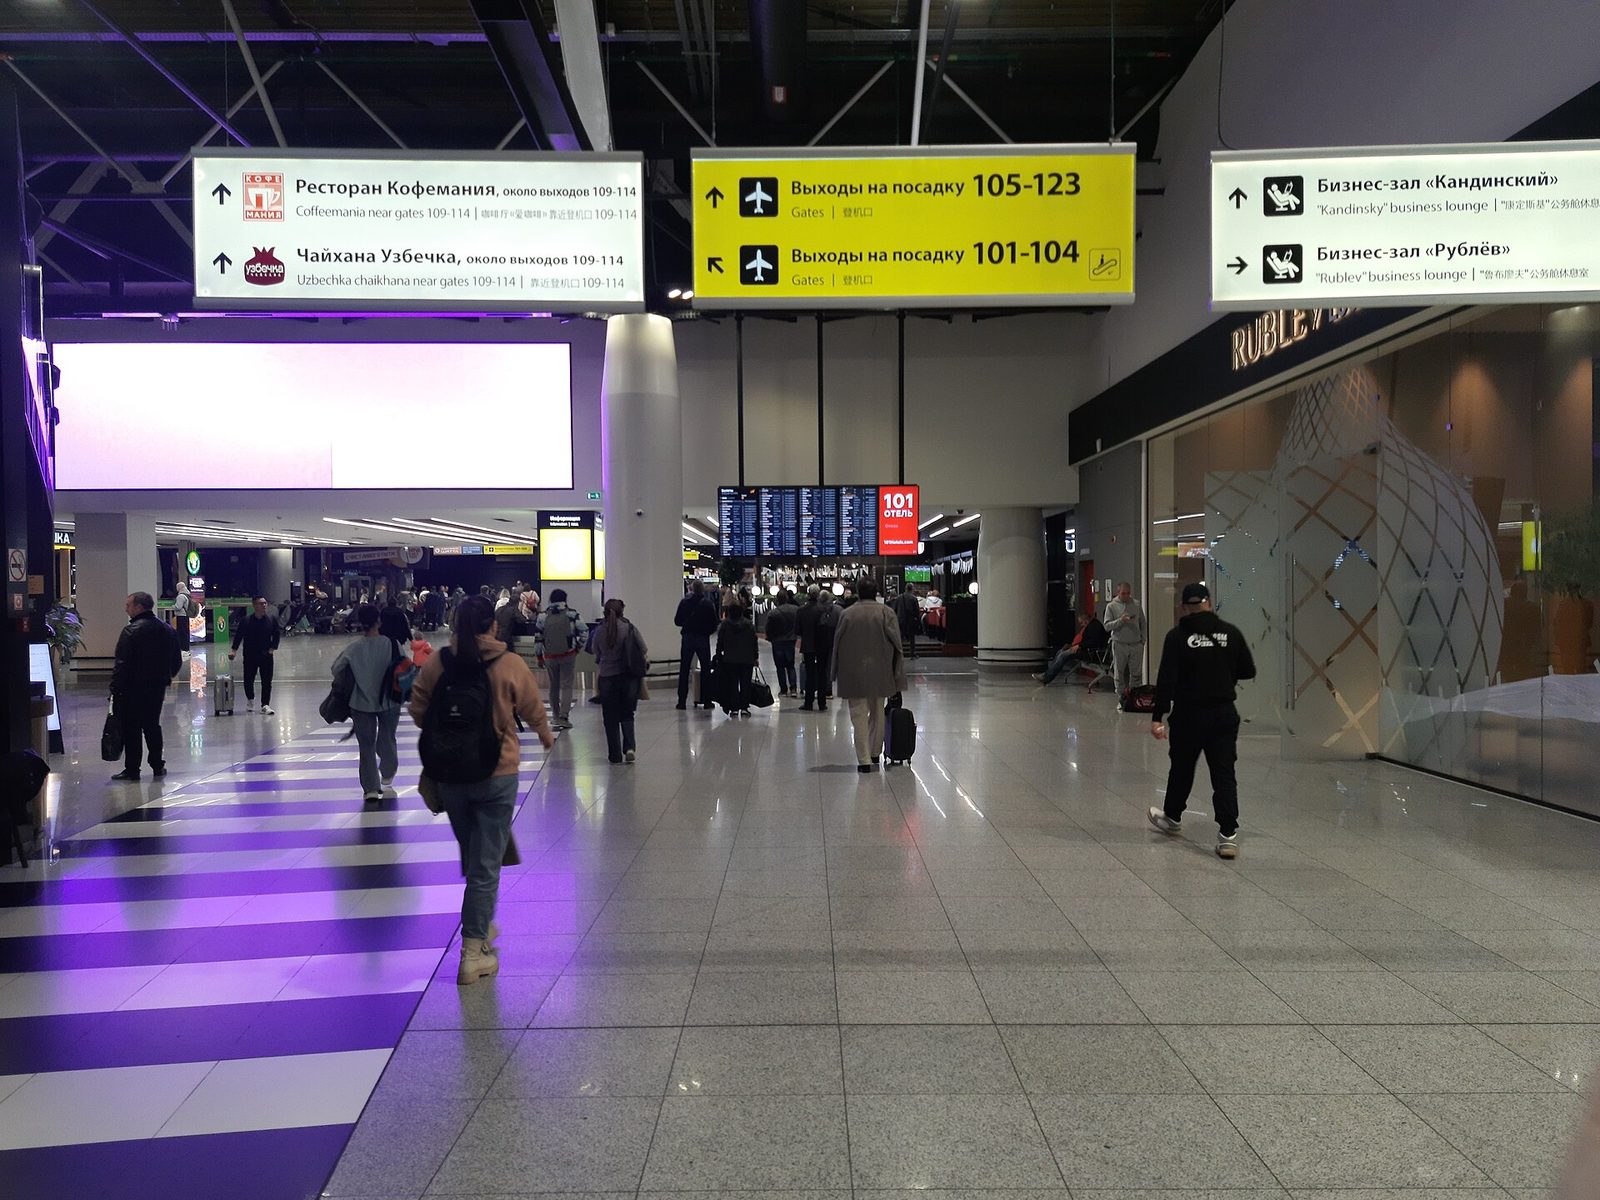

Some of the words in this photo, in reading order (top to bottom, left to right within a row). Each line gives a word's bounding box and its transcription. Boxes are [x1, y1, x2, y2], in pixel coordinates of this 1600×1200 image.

[245, 175, 281, 183] КОФЕ
[791, 180, 863, 198] Выходы
[867, 183, 888, 195] на
[892, 182, 965, 200] посадку
[972, 171, 1081, 197] 105-123
[1317, 176, 1421, 194] Бизнес-зал
[1425, 171, 1559, 192] «Кандинский»
[296, 178, 382, 199] Ресторан
[387, 180, 500, 200] Кофемания,
[502, 187, 538, 197] около
[539, 188, 590, 200] выходов
[592, 186, 637, 198] 109-114
[246, 211, 282, 219] МАНИЯ
[295, 204, 366, 219] Coffeemania
[368, 208, 393, 219] near
[394, 208, 425, 222] gates
[427, 207, 471, 219] 109-114
[595, 208, 638, 220] 109-114
[791, 206, 825, 219] Gates
[842, 207, 873, 218] 登机口
[1316, 201, 1389, 217] "Kandinsky"
[1390, 201, 1443, 214] business
[1445, 199, 1489, 215] lounge
[296, 246, 376, 263] Чайхана
[380, 247, 461, 267] Узбечка,
[466, 255, 507, 265] около
[509, 256, 569, 267] выходов
[572, 255, 624, 266] 109-114
[791, 248, 863, 266] Выходы
[867, 251, 888, 262] на
[892, 249, 965, 267] посадку
[972, 240, 1081, 265] 101-104
[1317, 246, 1421, 262] Бизнес-зал
[1425, 240, 1511, 261] «Рублёв»
[297, 273, 352, 288] Uzbechka
[353, 273, 411, 288] chaikhana
[412, 277, 438, 287] near
[439, 276, 470, 291] gates
[472, 275, 517, 288] 109-114
[582, 277, 625, 289] 109-114
[791, 274, 825, 286] Gates
[842, 274, 873, 286] 登机口
[1315, 271, 1368, 285] "Rublev"
[1368, 270, 1421, 283] business
[1424, 268, 1468, 284] lounge
[884, 493, 913, 509] 101
[884, 510, 913, 518] ОТЕЛЬ
